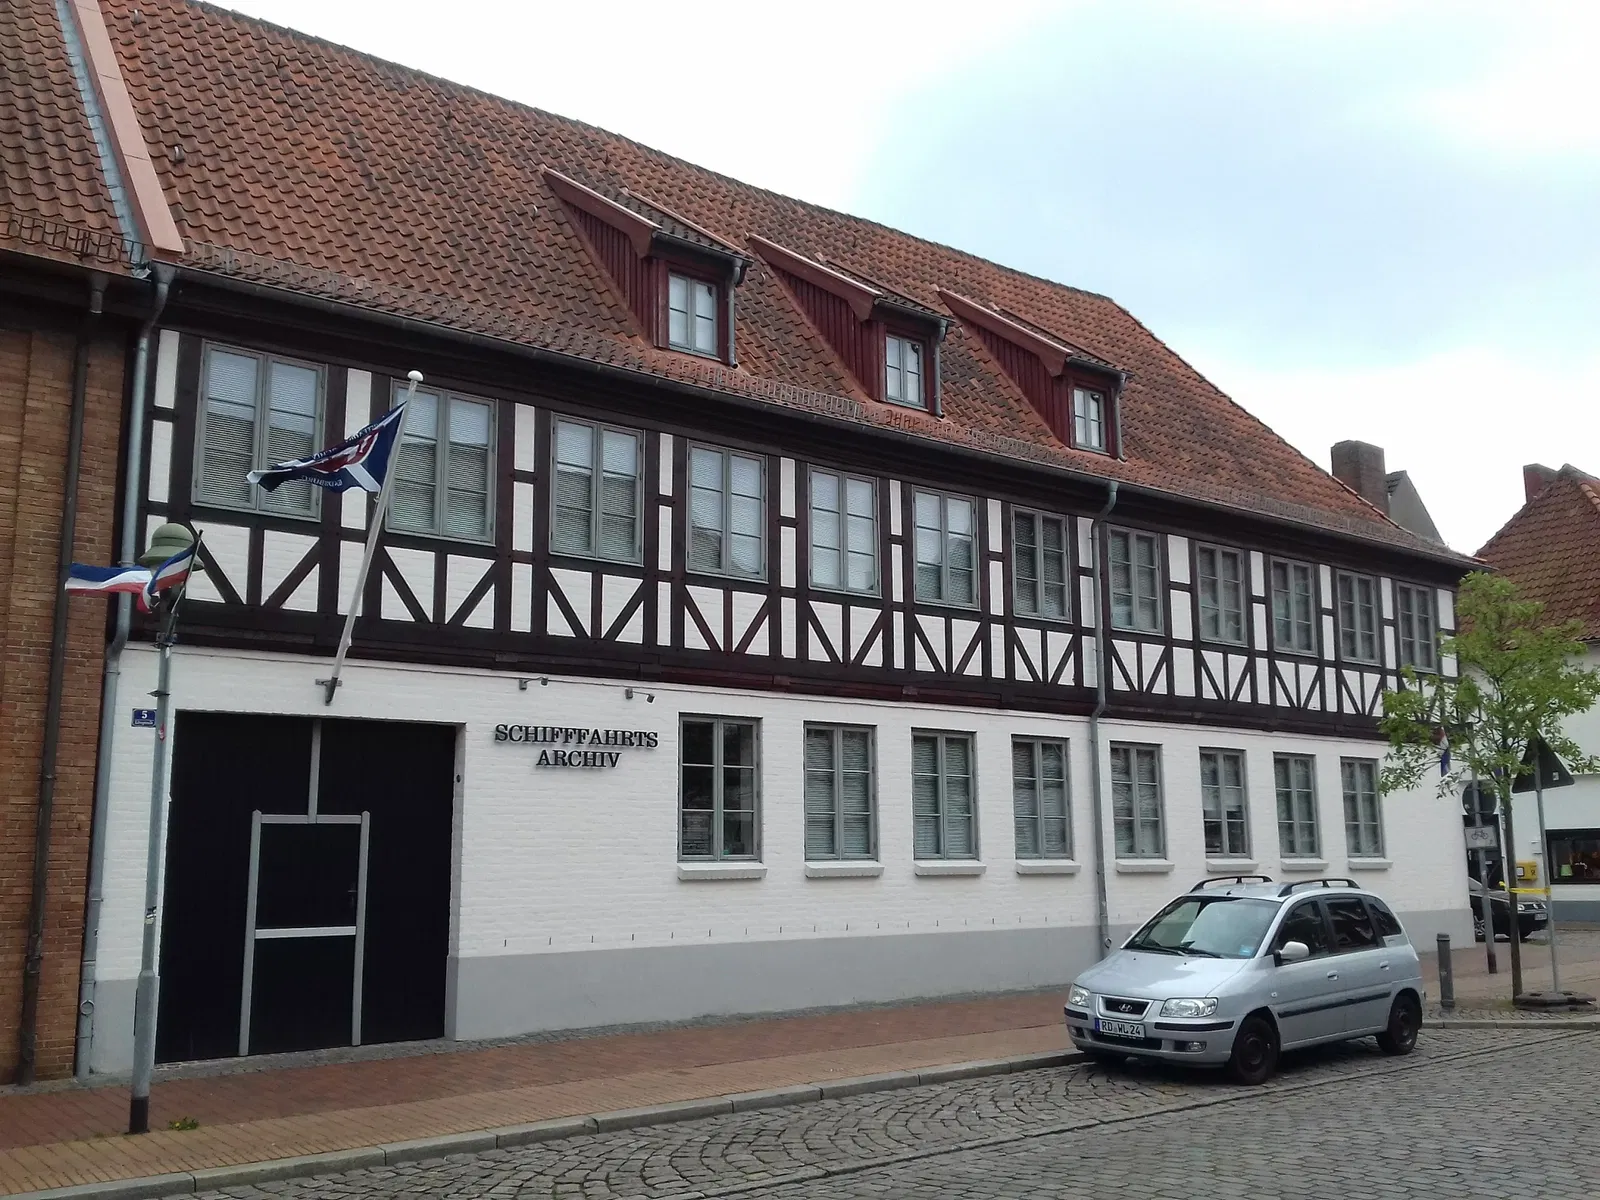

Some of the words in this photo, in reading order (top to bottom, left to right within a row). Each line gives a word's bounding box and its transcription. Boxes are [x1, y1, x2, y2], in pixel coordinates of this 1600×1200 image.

[141, 710, 148, 719] 5
[494, 724, 659, 748] SCHIFFFAHRTS
[536, 750, 622, 768] ARCHIV
[1101, 1020, 1113, 1032] RD
[1130, 1024, 1141, 1036] 24
